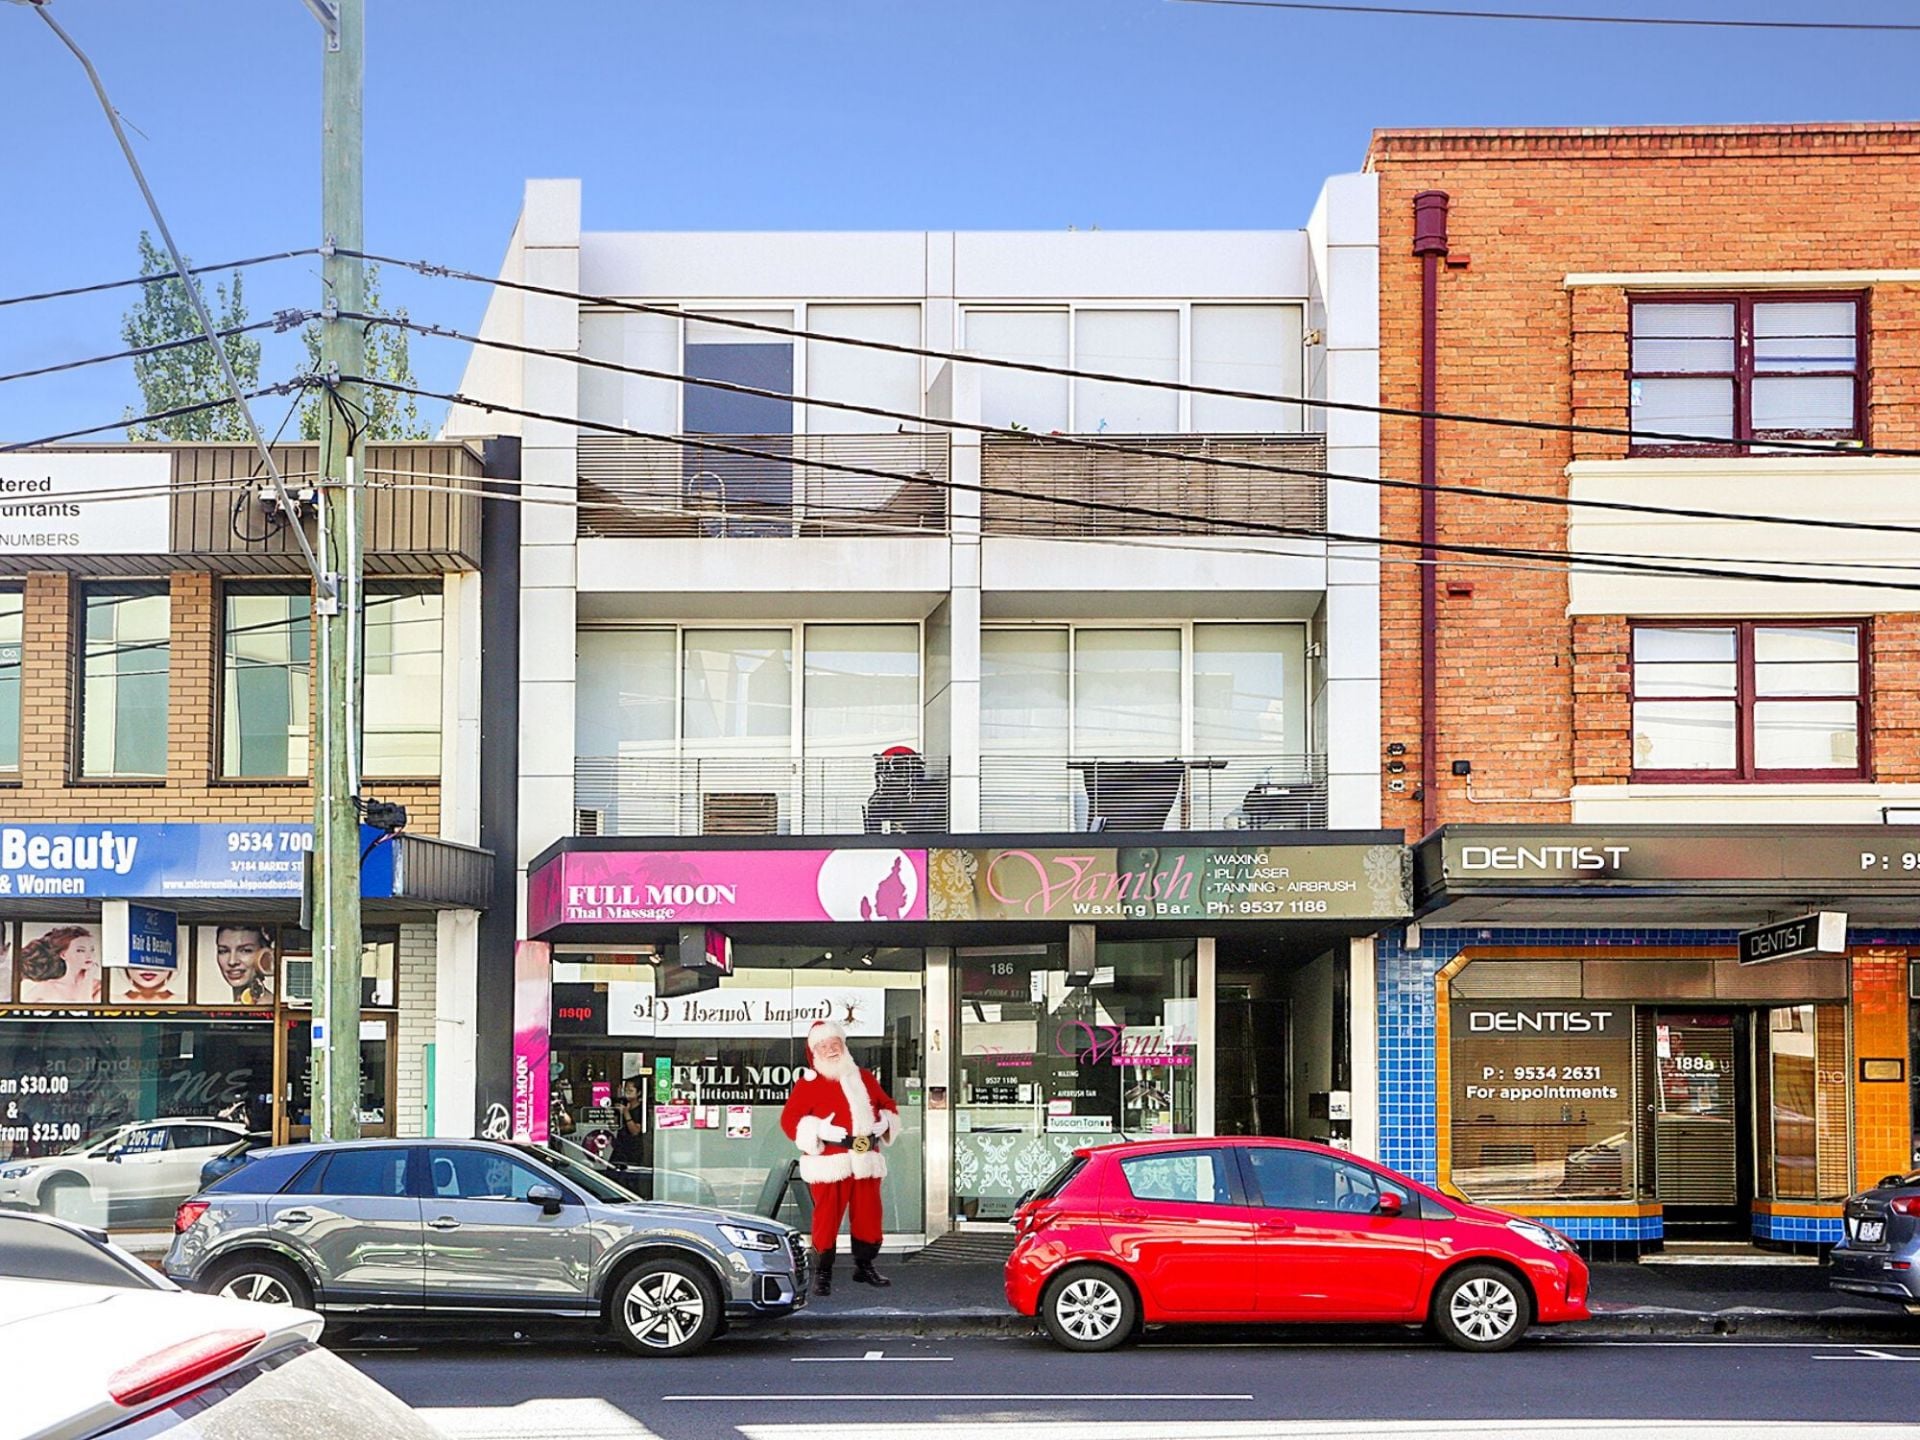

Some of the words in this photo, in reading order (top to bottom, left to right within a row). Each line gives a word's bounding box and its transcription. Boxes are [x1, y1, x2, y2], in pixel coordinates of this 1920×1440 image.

[0, 532, 80, 547] NUMBERS
[227, 831, 274, 852] 9534
[279, 831, 314, 852] 700
[2, 828, 138, 875] Beauty
[1213, 853, 1269, 865] WAXING
[1461, 846, 1630, 870] DENTIST
[986, 850, 1194, 914] Vanish
[1213, 868, 1235, 880] IPL
[1245, 868, 1289, 879] LASER
[0, 874, 13, 894] &
[17, 874, 85, 895] Women
[1213, 882, 1276, 893] TANNING
[1287, 880, 1357, 892] AIRBRUSH
[567, 884, 640, 906] FULL
[645, 884, 738, 906] MOON
[567, 906, 602, 919] Thai
[606, 906, 675, 921] Massage
[1072, 903, 1147, 917] Waxing
[1156, 903, 1191, 915] Bar
[1206, 901, 1235, 914] Ph:
[1239, 901, 1285, 914] 9537
[1288, 900, 1328, 913] 1186
[1750, 924, 1807, 957] DENTIST
[989, 962, 1014, 975] 186
[1469, 1011, 1613, 1032] DENTIST
[1056, 1020, 1193, 1066] Vanish
[1674, 1056, 1715, 1071] 188a
[516, 1055, 528, 1098] MOON
[671, 1065, 740, 1086] FULL
[745, 1065, 806, 1087] MOO
[1513, 1066, 1557, 1081] 9534
[1561, 1066, 1601, 1081] 2631
[20, 1075, 69, 1095] $30.00
[756, 1088, 790, 1101] Thai
[1466, 1085, 1496, 1099] For
[1500, 1085, 1618, 1101] appointments
[6, 1101, 18, 1119] &
[0, 1124, 29, 1141] rom
[32, 1122, 81, 1143] $25.00
